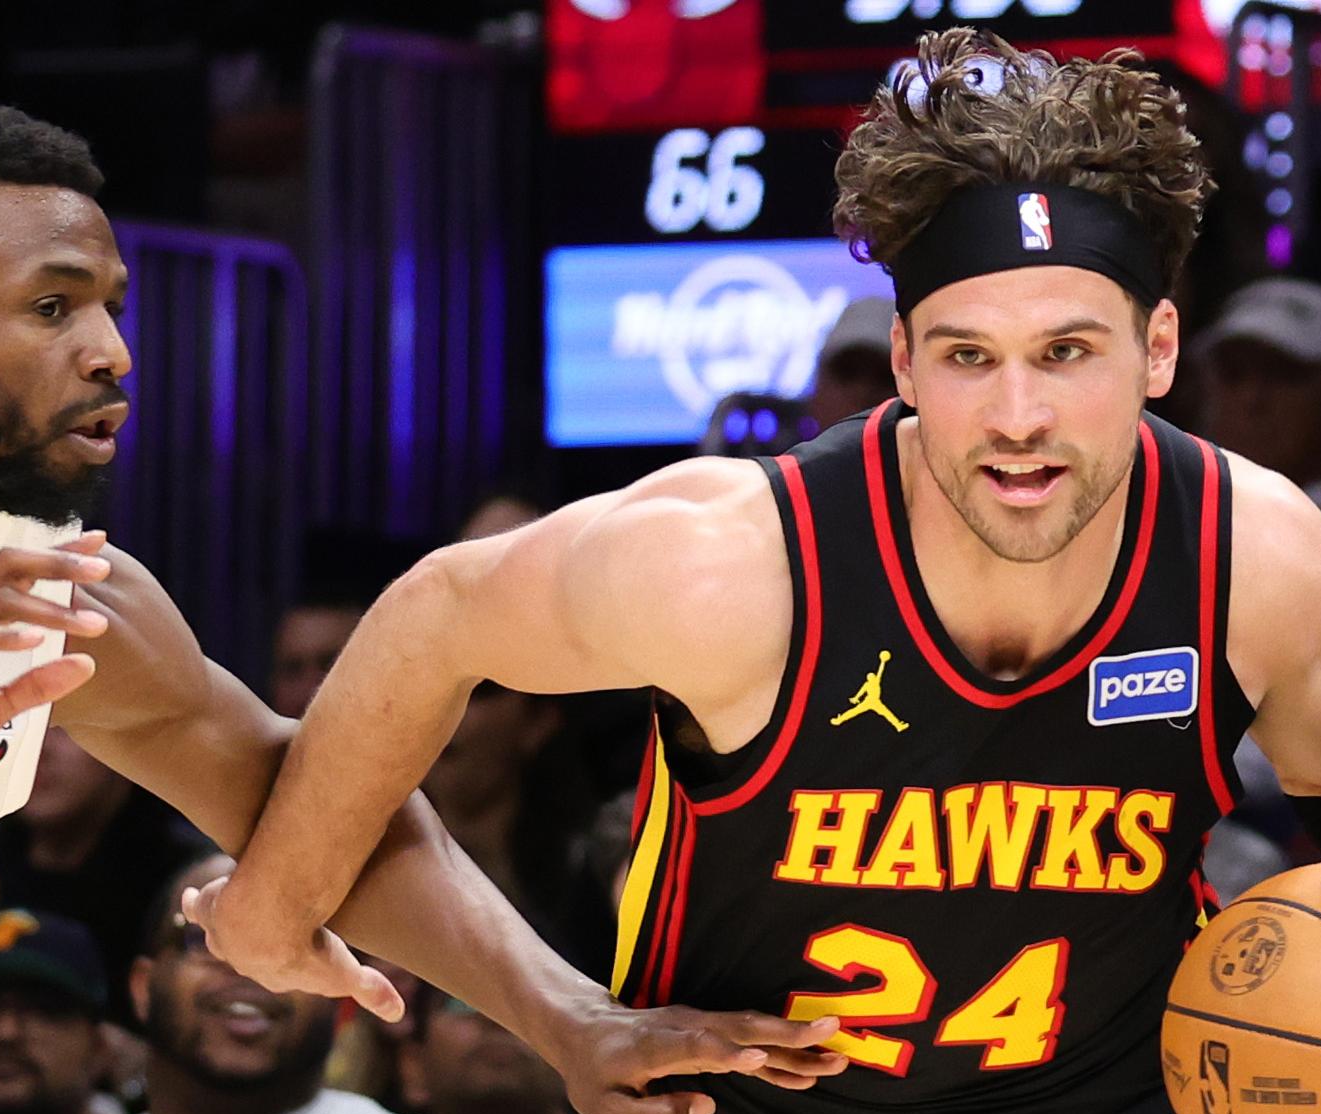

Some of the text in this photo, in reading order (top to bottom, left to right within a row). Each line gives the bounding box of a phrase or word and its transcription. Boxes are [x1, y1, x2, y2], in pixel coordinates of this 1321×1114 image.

[644, 126, 766, 234] 66
[1099, 667, 1187, 708] paze
[772, 781, 1176, 894] HAWKS
[784, 922, 1071, 1078] 24
